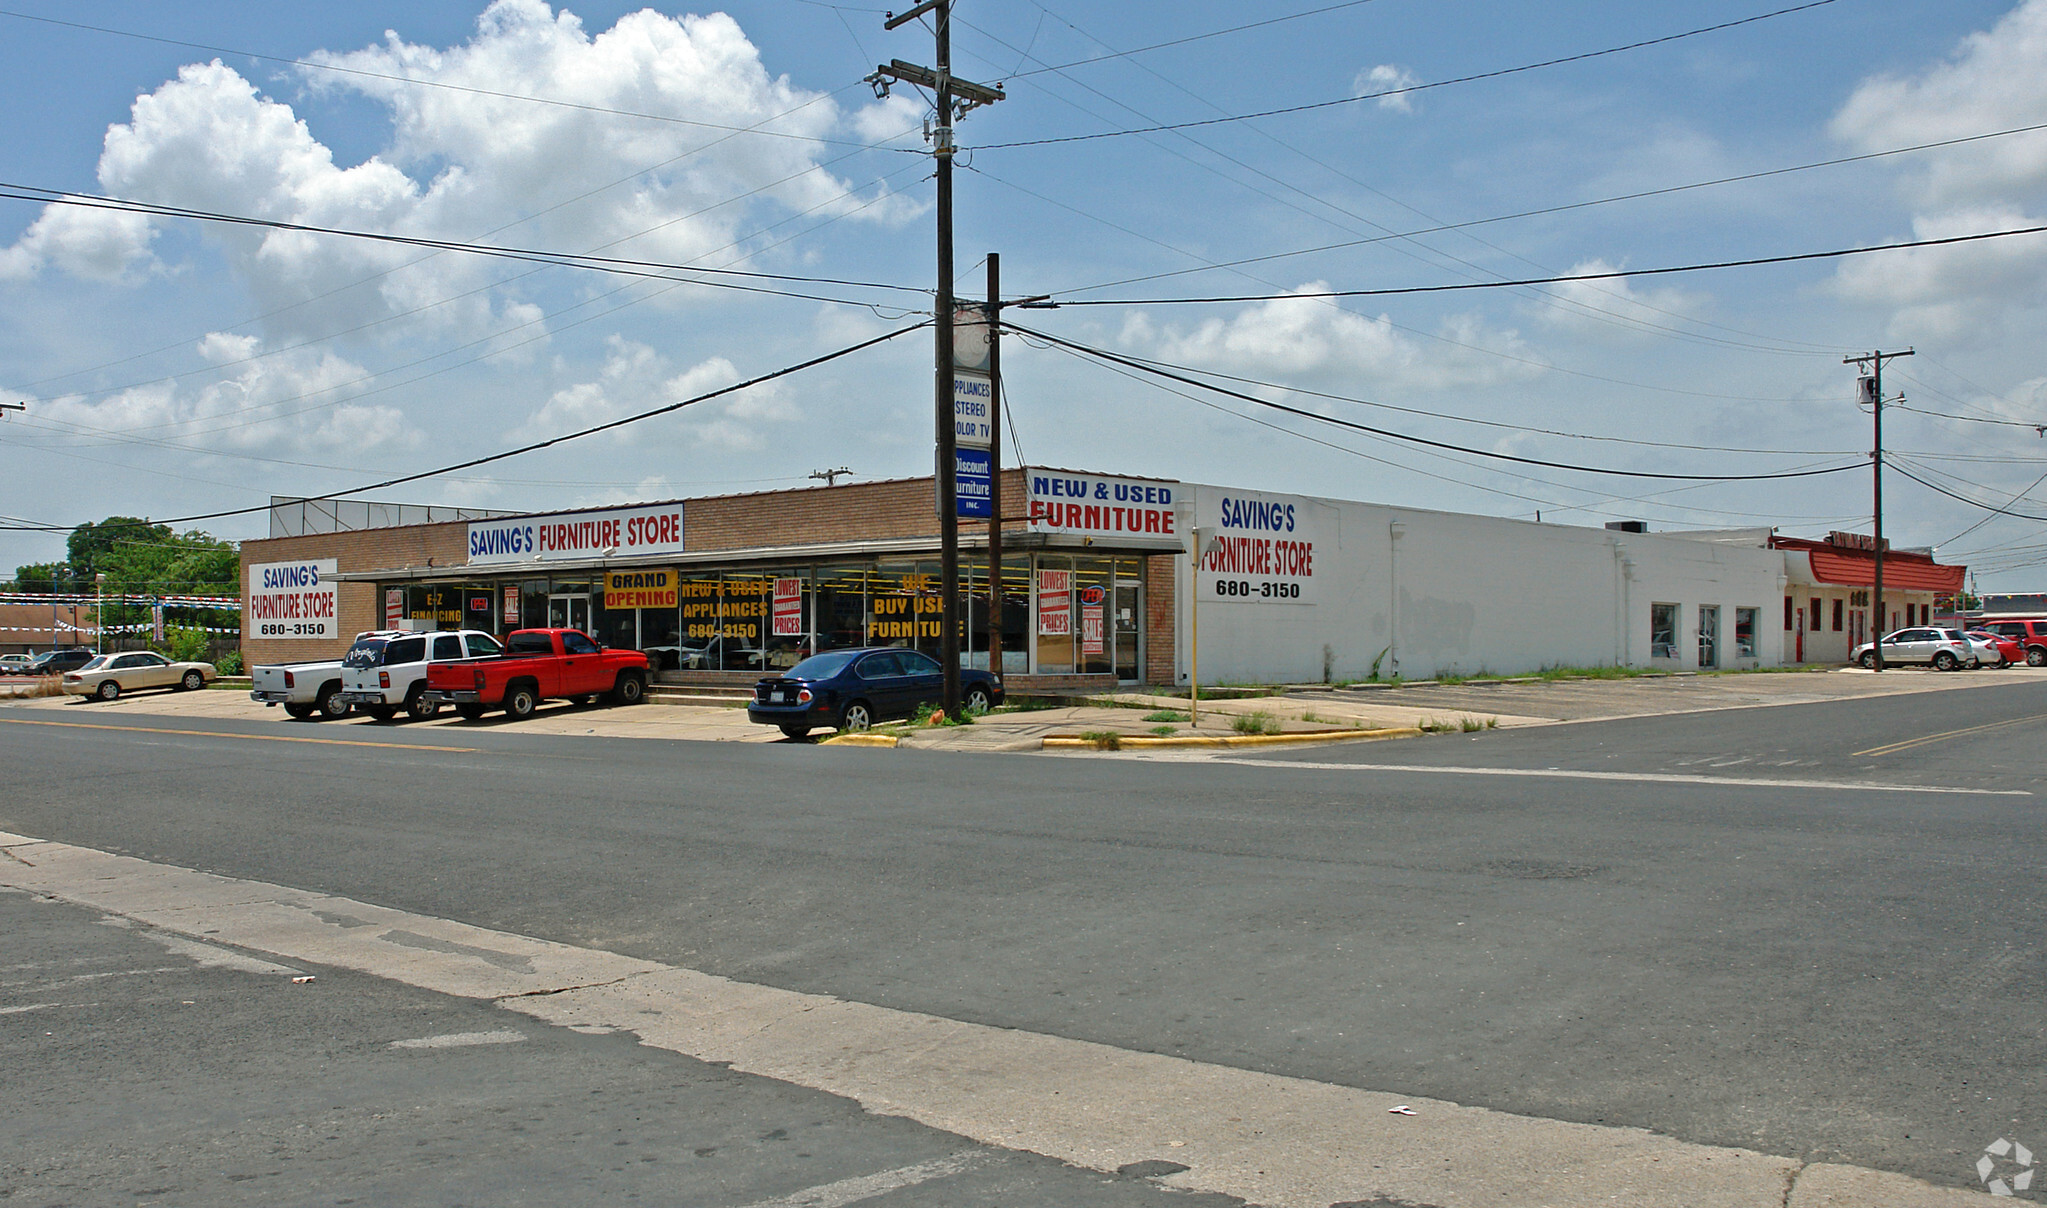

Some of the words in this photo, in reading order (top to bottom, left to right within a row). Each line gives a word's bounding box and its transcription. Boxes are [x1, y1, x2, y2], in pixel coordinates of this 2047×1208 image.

[954, 380, 990, 398] PPLIANCES
[956, 401, 986, 417] STEREO
[956, 421, 976, 437] OLOR
[980, 424, 990, 437] TV
[956, 480, 990, 496] urniture
[1034, 477, 1087, 498] NEW
[1094, 482, 1109, 500] &
[1115, 484, 1171, 504] USED
[1031, 501, 1174, 534] FURNITURE
[1221, 497, 1295, 532] SAVING'S
[471, 525, 533, 556] SAVING'S
[540, 519, 620, 551] FURNITURE
[628, 514, 679, 546] STORE
[1275, 540, 1312, 576] STORE
[264, 565, 319, 588] SAVING'S
[612, 573, 667, 589] GRAND
[902, 575, 929, 590] WE
[1040, 571, 1068, 590] LOWEST
[682, 583, 712, 597] NEW
[716, 582, 725, 597] &
[731, 581, 768, 596] USED
[774, 579, 800, 596] LOWEST
[1216, 580, 1299, 598] 680-3150
[252, 593, 300, 619] FURNITURE
[303, 592, 333, 618] STORE
[427, 593, 443, 606] E-Z
[606, 590, 675, 606] OPENING
[874, 598, 907, 614] BUY
[913, 597, 943, 613] USE
[684, 602, 768, 618] APPLIANCES
[261, 623, 325, 635] 680-3150
[688, 624, 757, 638] 680-3150
[774, 617, 800, 633] PRICES
[869, 621, 964, 638] FURNITUE
[1041, 614, 1069, 632] PRICES
[1083, 619, 1102, 642] SALE
